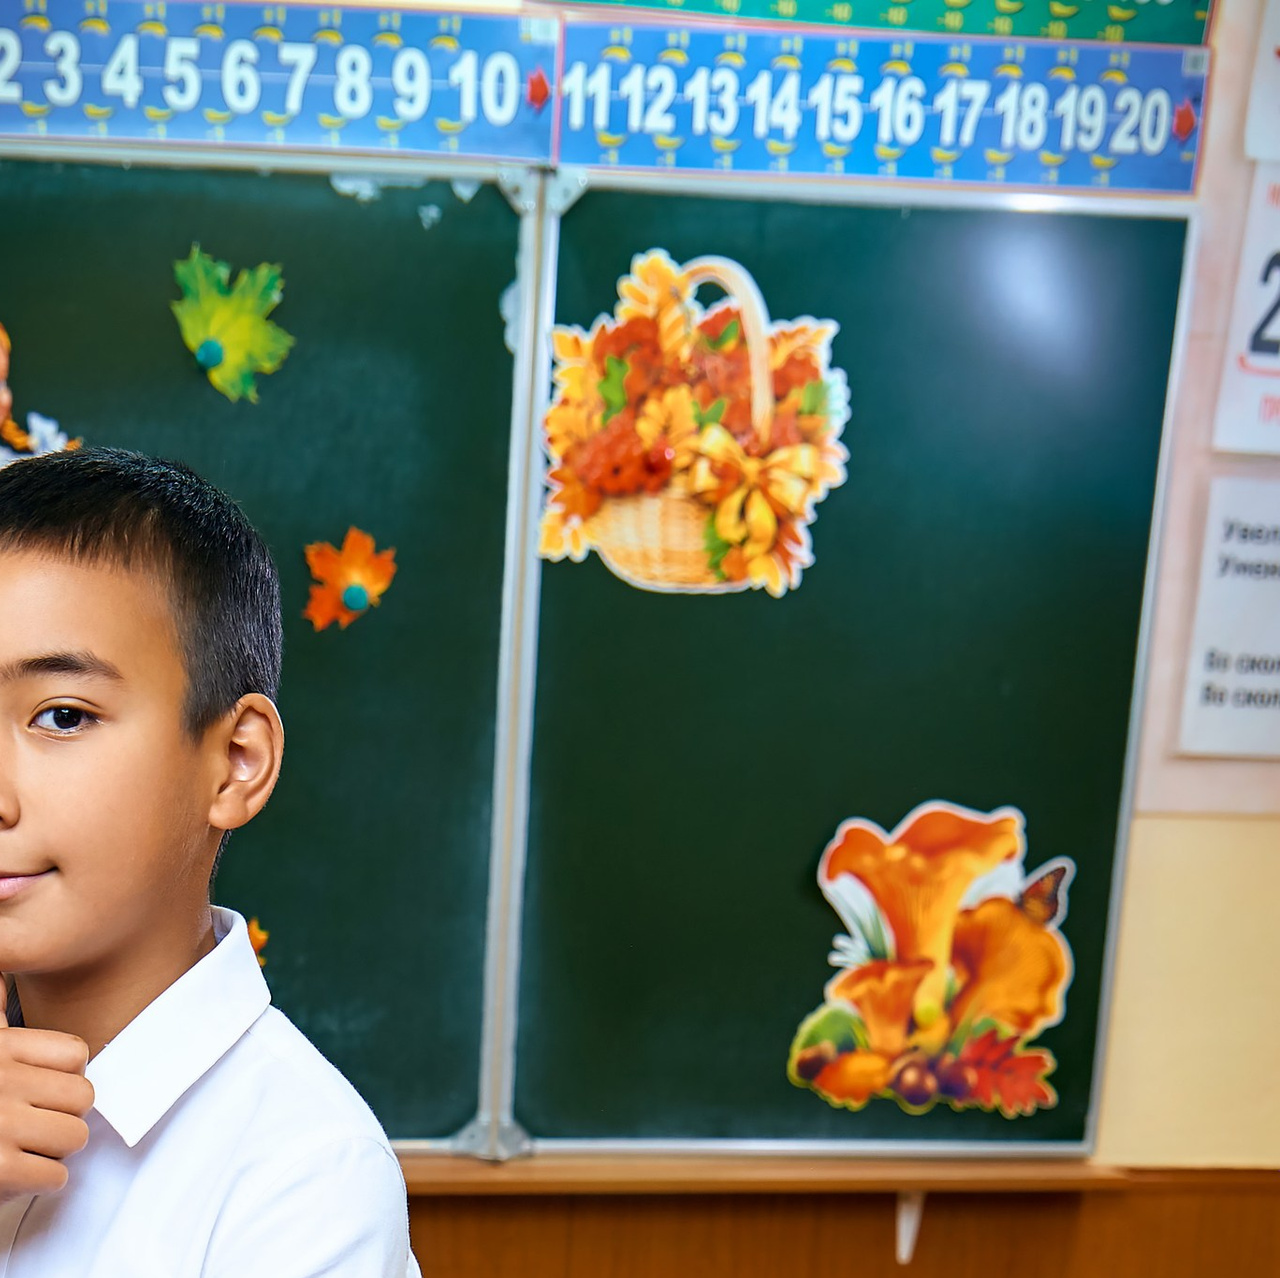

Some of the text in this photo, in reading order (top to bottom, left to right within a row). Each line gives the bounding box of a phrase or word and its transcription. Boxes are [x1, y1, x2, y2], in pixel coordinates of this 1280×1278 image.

[44, 31, 82, 107] 3
[102, 34, 143, 109] 4
[163, 37, 202, 112] 5
[221, 39, 261, 114] 6
[278, 42, 317, 117] 7
[333, 44, 372, 119] 8
[392, 47, 432, 122] 9
[449, 50, 520, 126] 10
[562, 61, 1170, 154] 11 12 13 14 15 16 17 18 19 20
